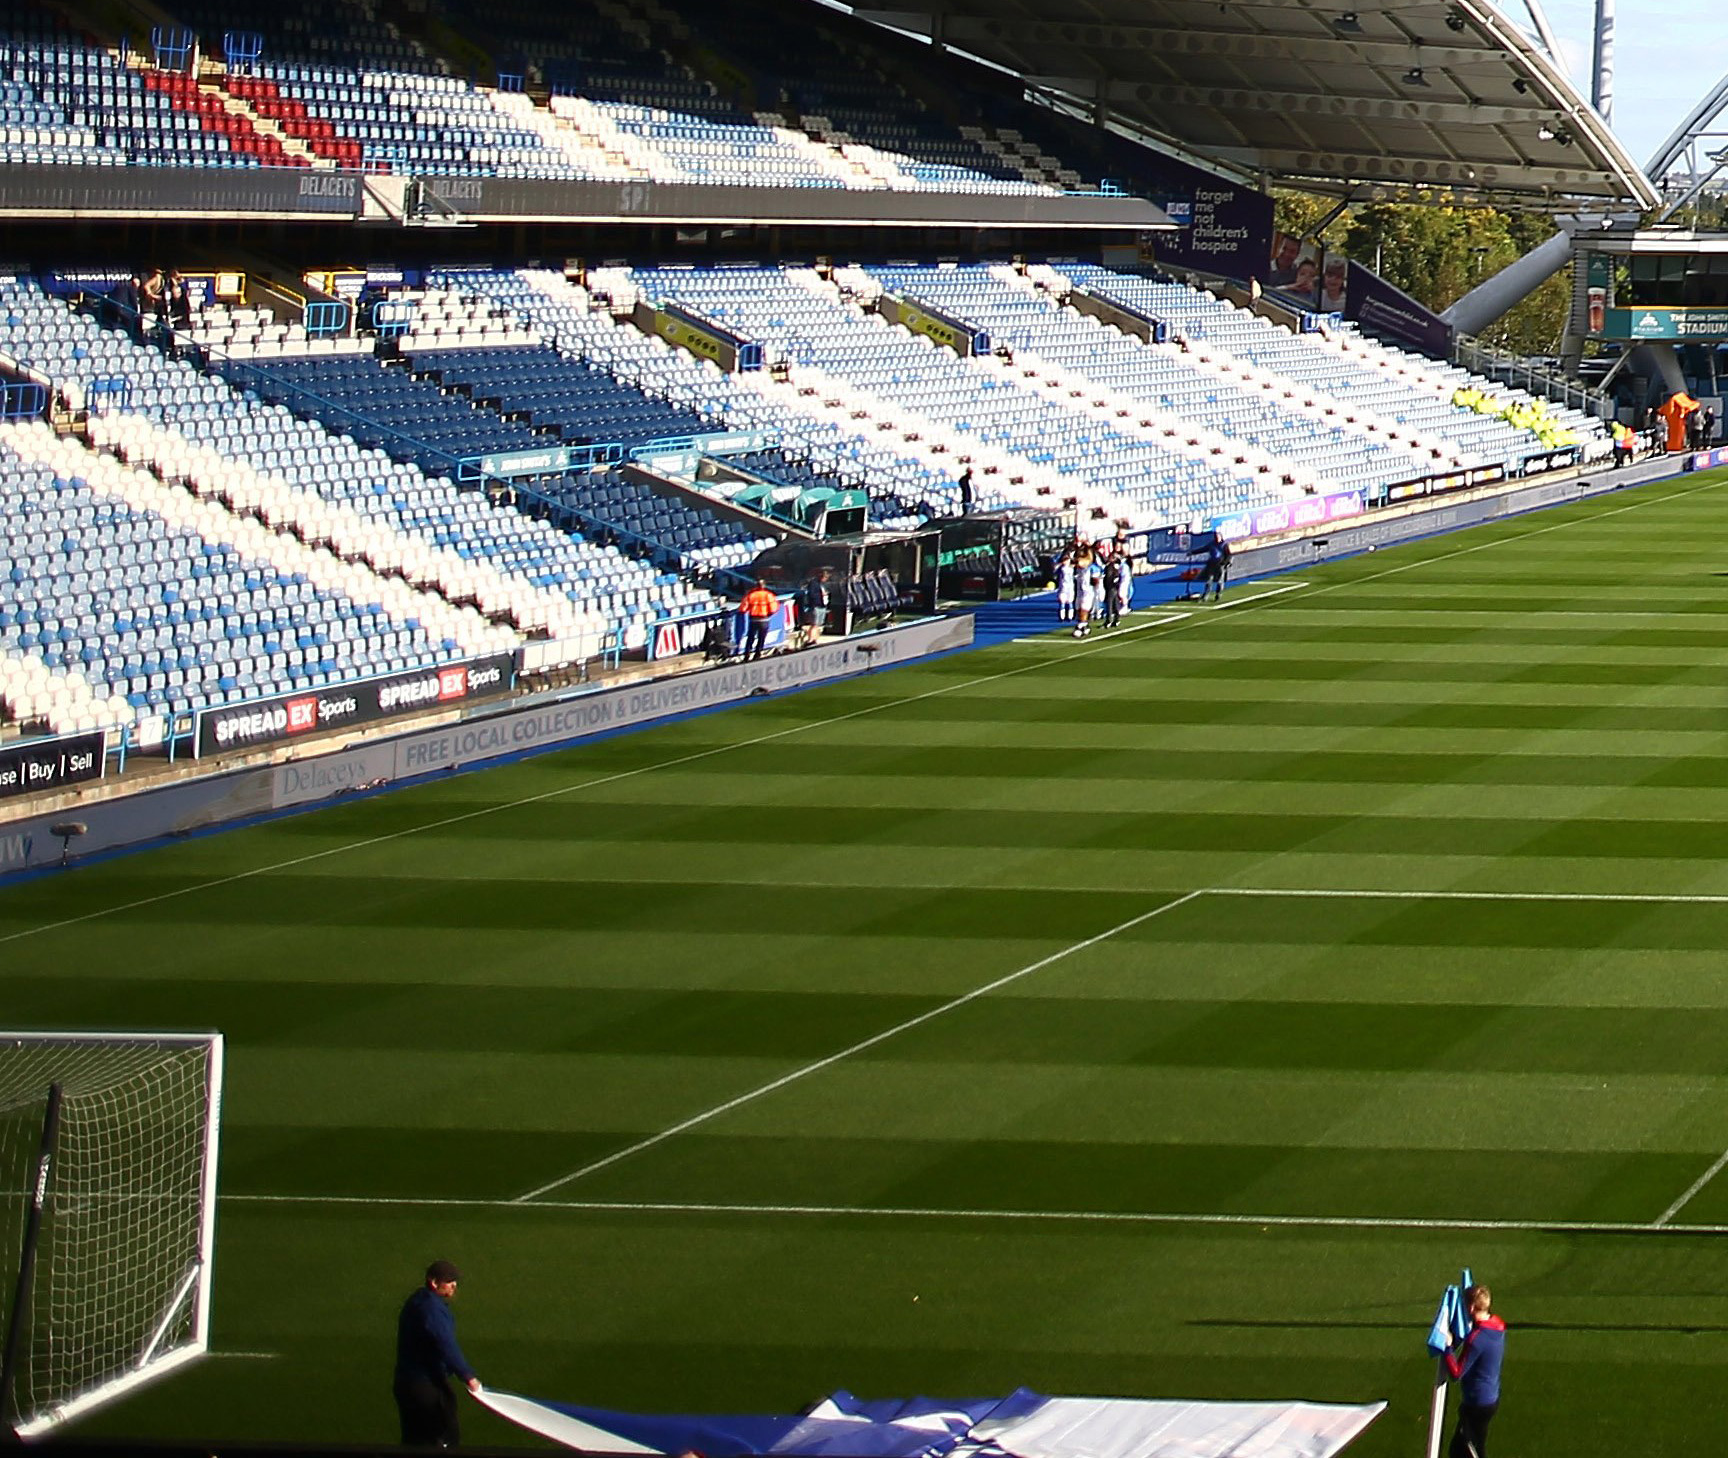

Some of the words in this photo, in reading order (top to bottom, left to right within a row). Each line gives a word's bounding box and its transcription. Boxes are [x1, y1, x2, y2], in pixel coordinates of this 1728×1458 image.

[300, 177, 355, 196] DELACEYS
[1195, 188, 1234, 203] forget
[1196, 203, 1214, 213] me
[1195, 212, 1215, 224] not
[1193, 225, 1248, 238] children's
[1192, 238, 1238, 254] hospice
[1677, 323, 1728, 334] STADIUM
[467, 666, 500, 688] Sports
[318, 697, 356, 722] Sports
[406, 741, 450, 767] FREE
[454, 729, 510, 756] LOCAL
[513, 702, 612, 741] COLLECTION
[616, 699, 626, 717] &
[630, 683, 700, 714] DELIVERY
[701, 665, 774, 702] AVAILABLE
[775, 659, 806, 683] CALL
[29, 762, 56, 782] Buy
[70, 753, 92, 772] Sell
[284, 757, 366, 793] Delaceys
